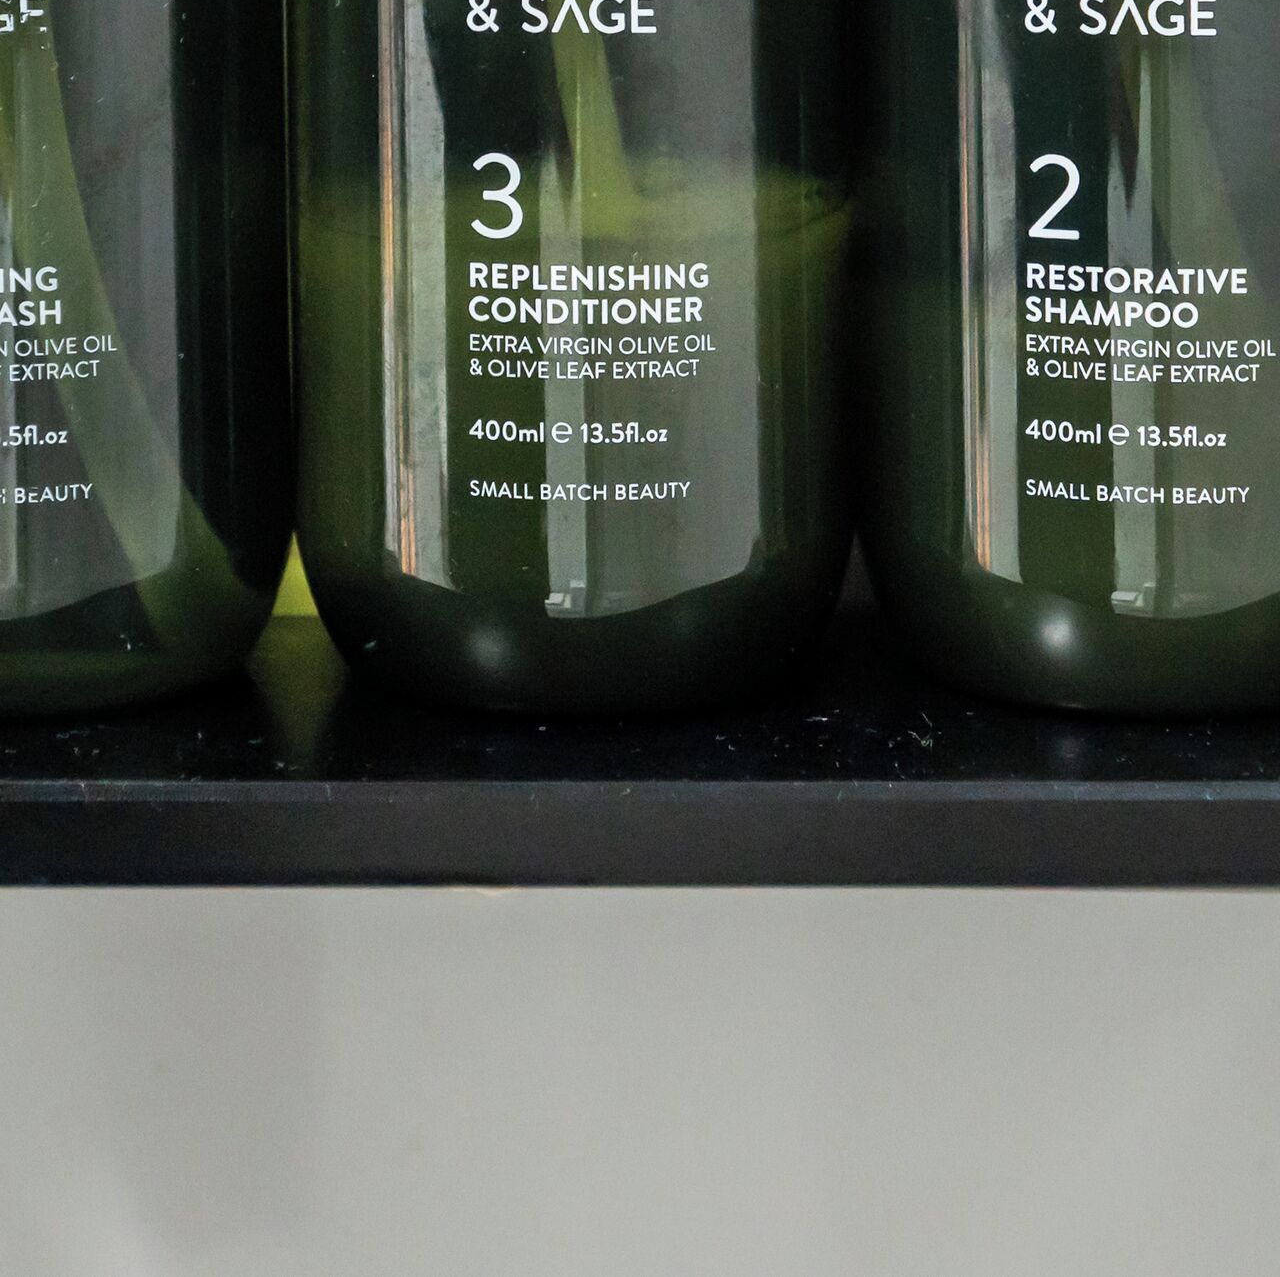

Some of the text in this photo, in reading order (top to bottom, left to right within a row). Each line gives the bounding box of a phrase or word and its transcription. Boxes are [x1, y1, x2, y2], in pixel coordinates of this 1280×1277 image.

[470, 152, 523, 238] 3
[1028, 153, 1079, 240] 2
[469, 262, 709, 291] REPLENISHING
[1026, 262, 1247, 294] RESTORATIVE
[468, 295, 702, 324] CONDITIONER
[1026, 296, 1198, 328] SHAMPOO
[15, 337, 77, 356] OLIVE
[83, 335, 117, 353] OIL
[469, 333, 715, 354] EXTRA VIRGIN OLIVE OIL
[1026, 333, 1275, 358] EXTRA VIRGIN OLIVE OIL
[9, 359, 99, 381] EXTRACT
[469, 358, 699, 378] & OLIVE LEAF EXTRACT
[1026, 358, 1259, 382] & OLIVE LEAF EXTRACT
[469, 419, 544, 442] 400ml
[580, 421, 667, 444] 13.5fl.oz
[1025, 419, 1100, 444] 400ml
[1137, 425, 1225, 446] 13.5fl.oz
[14, 483, 92, 503] BEAUTY
[470, 479, 690, 500] SMALL BATCH BEAUTY
[1026, 479, 1249, 504] SMALL BATCH BEAUTY
